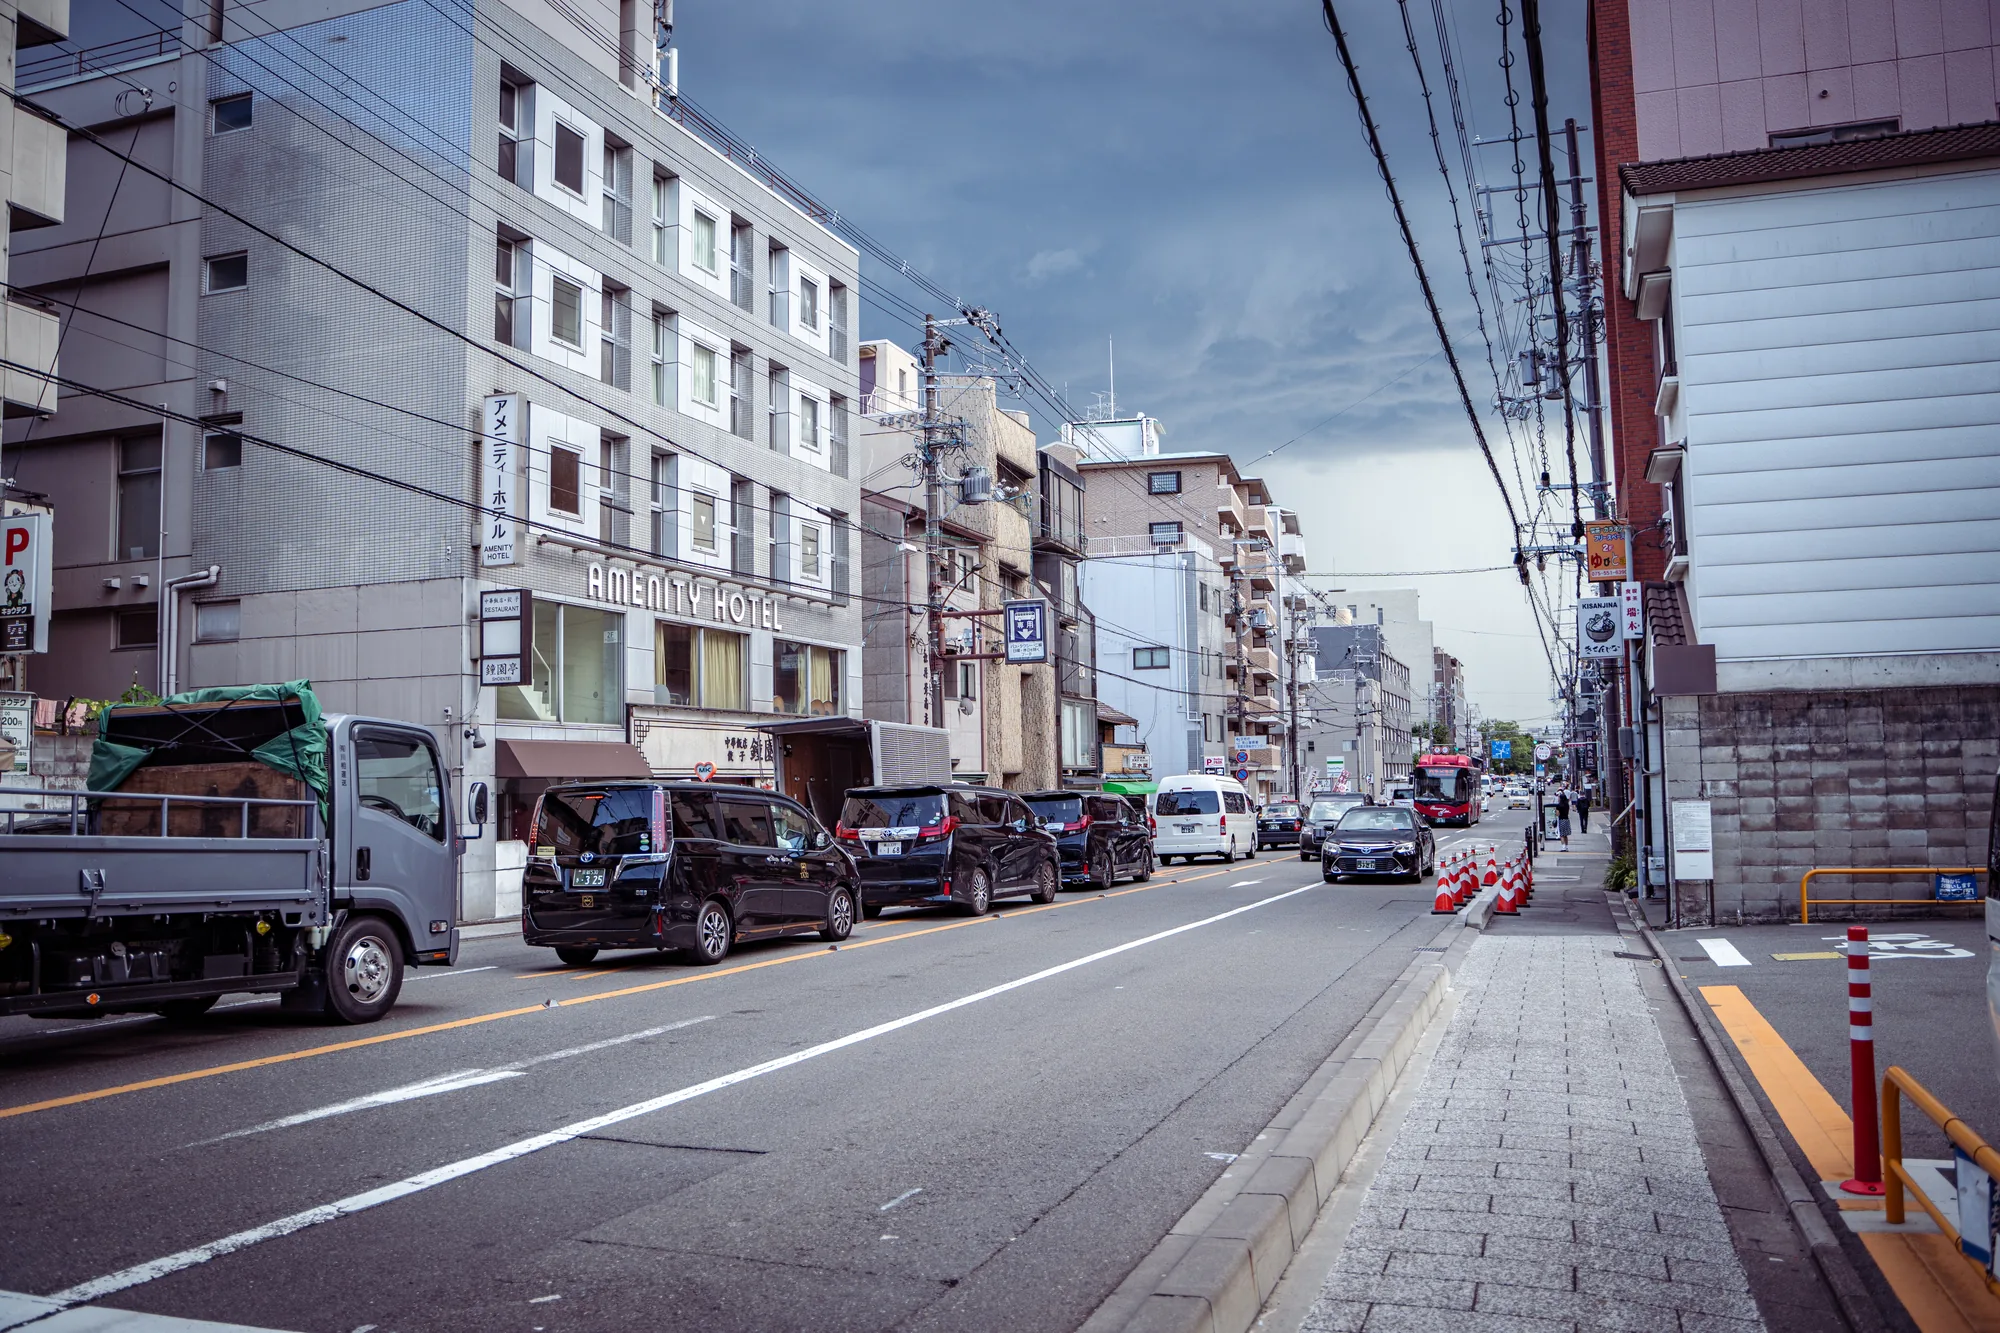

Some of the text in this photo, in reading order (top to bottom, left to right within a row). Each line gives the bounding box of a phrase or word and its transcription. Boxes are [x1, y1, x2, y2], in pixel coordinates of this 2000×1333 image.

[492, 399, 508, 539] アメニティーホテル
[5, 527, 30, 566] P
[484, 544, 513, 553] AMENITY
[487, 552, 510, 560] HOTEL
[588, 562, 783, 631] AMENITY HOTEL
[1, 606, 27, 615] キョウテク
[1582, 602, 1618, 610] KISANJINA
[7, 620, 27, 647] 空
